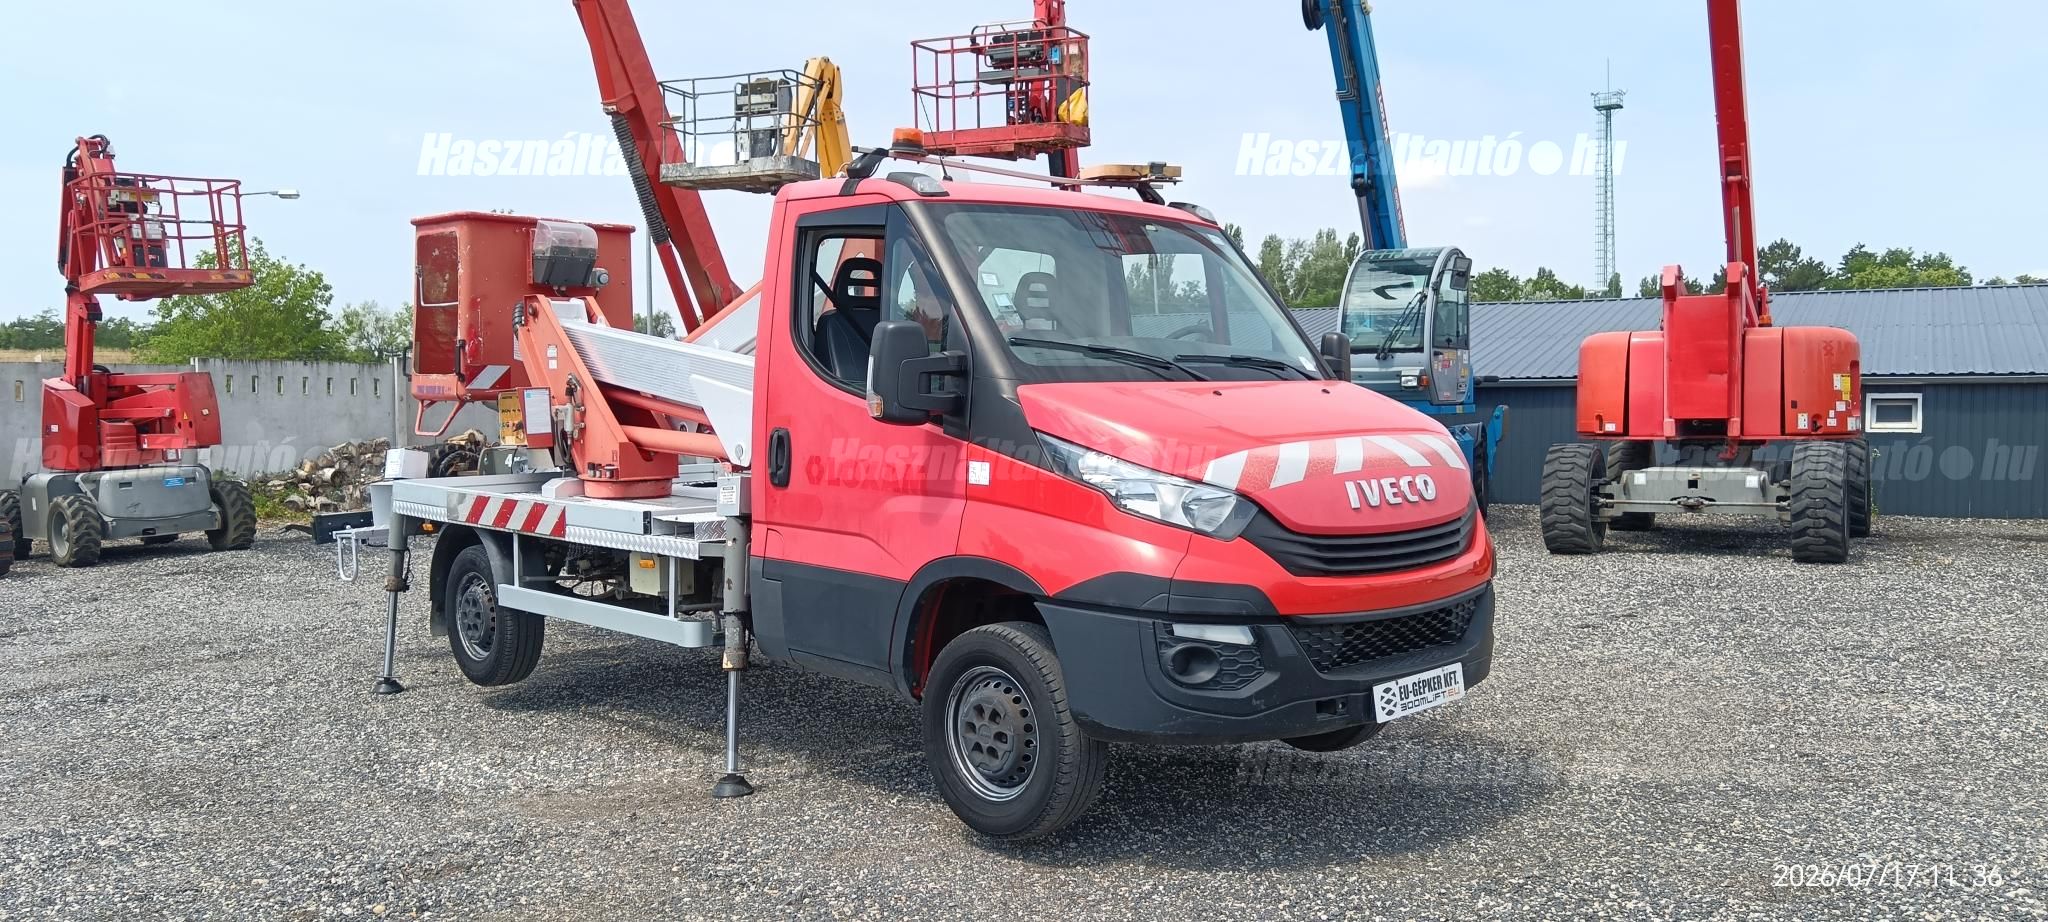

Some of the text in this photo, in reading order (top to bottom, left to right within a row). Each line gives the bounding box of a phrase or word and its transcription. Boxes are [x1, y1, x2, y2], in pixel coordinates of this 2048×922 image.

[1345, 474, 1436, 509] IVECO
[1399, 670, 1459, 702] EU-GÉPKER KFT.
